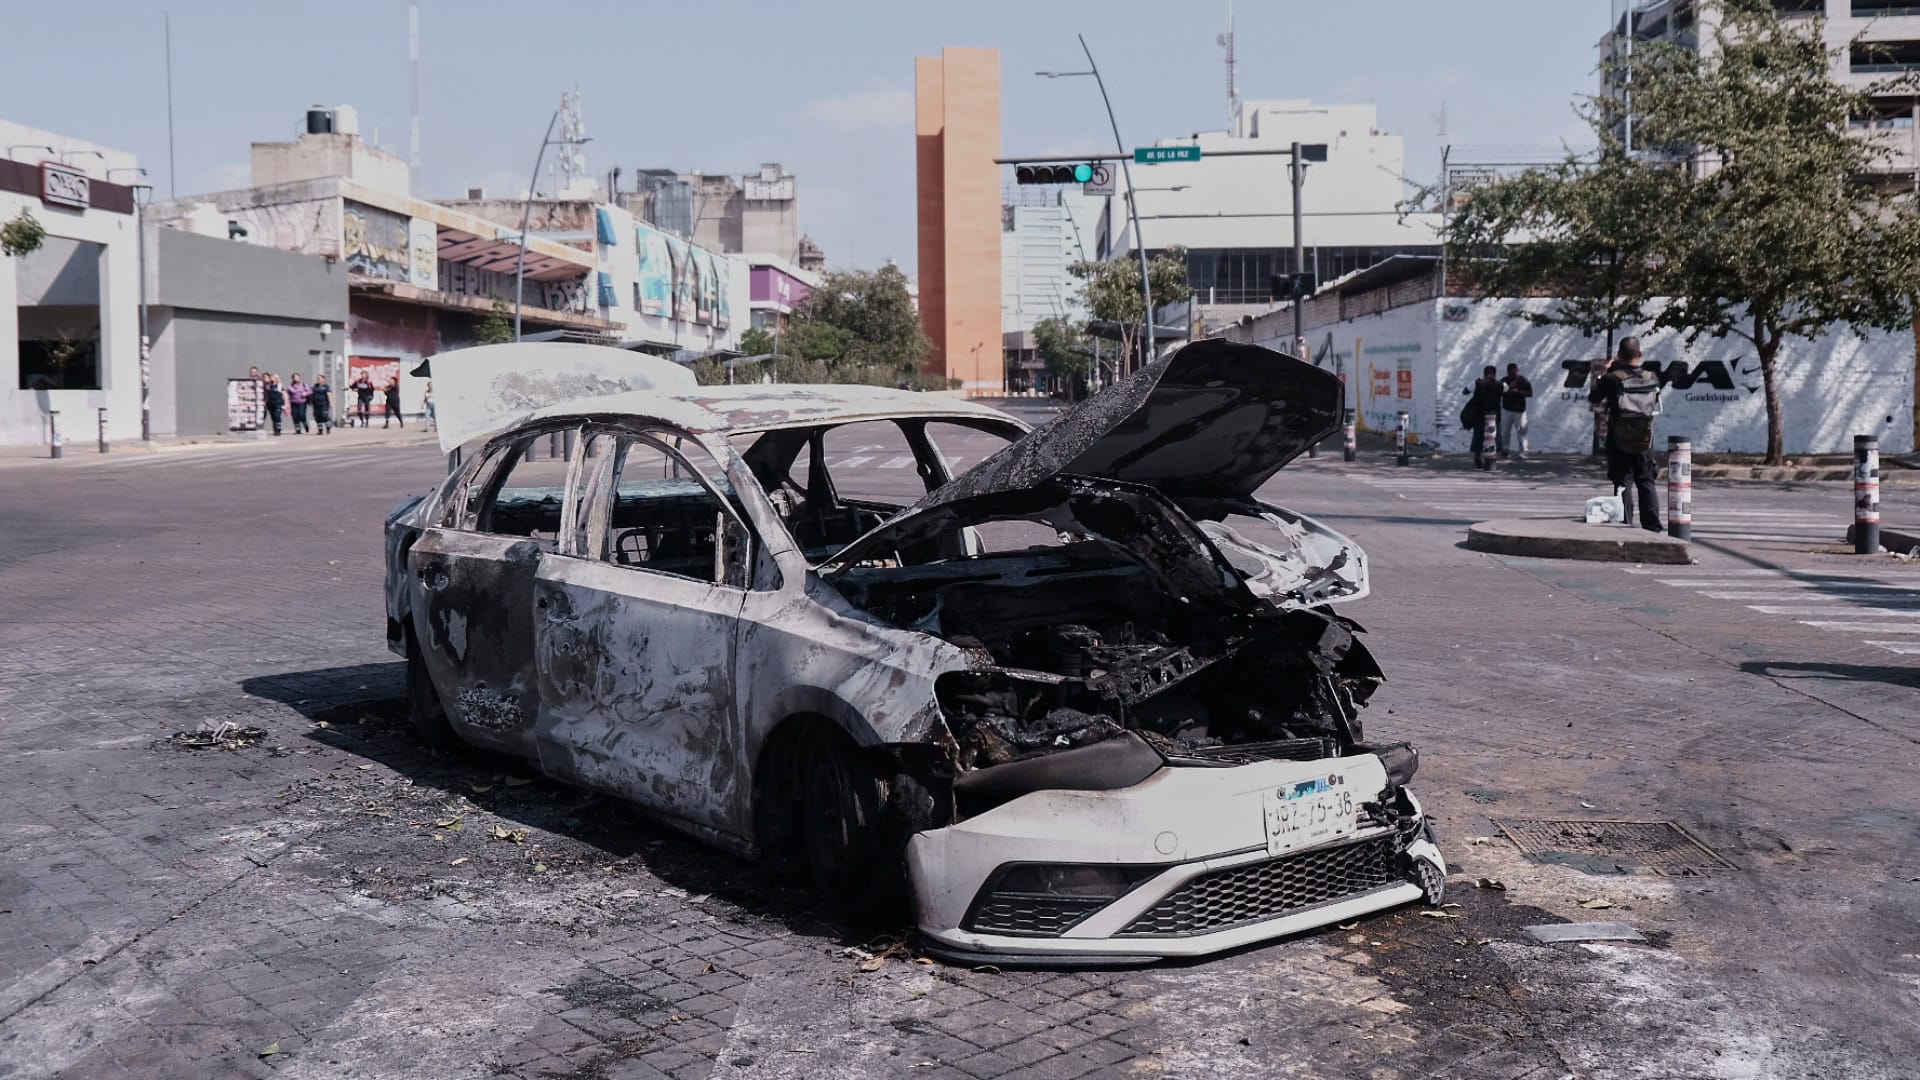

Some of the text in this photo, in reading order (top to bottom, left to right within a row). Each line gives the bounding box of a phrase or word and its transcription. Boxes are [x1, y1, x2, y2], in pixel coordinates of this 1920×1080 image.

[1157, 151, 1165, 159] DE
[1167, 151, 1175, 159] LA
[1177, 150, 1189, 158] PAZ
[1685, 392, 1740, 404] Guadalajara
